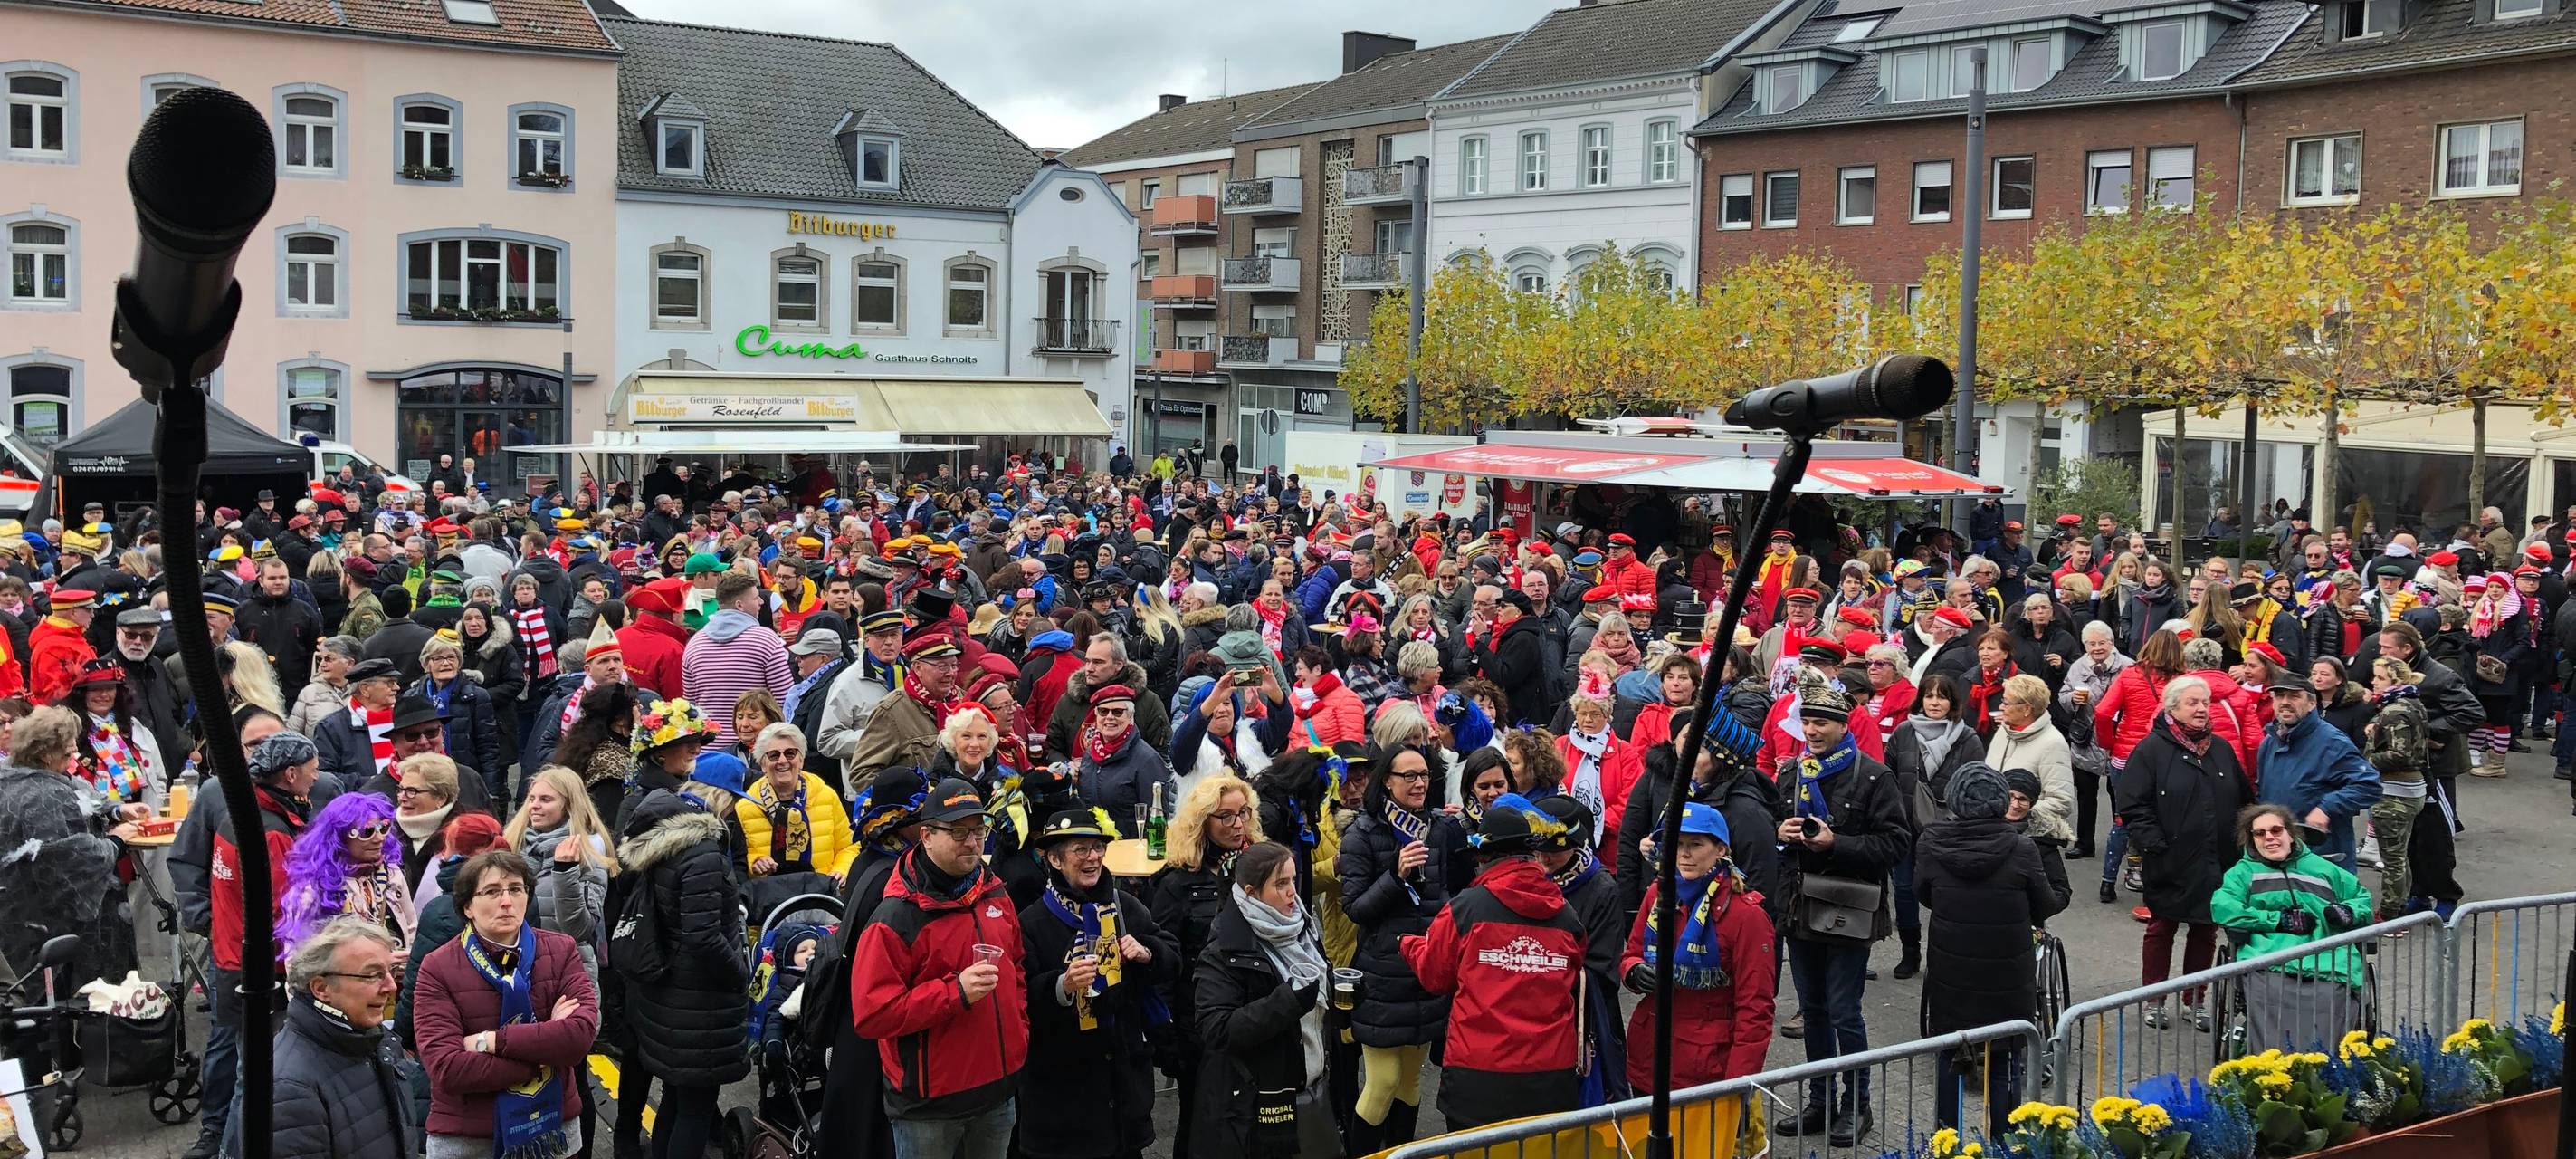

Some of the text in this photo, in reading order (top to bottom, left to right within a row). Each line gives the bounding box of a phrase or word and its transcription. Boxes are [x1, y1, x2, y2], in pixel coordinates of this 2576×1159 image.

[789, 210, 897, 242] Bitburger
[736, 324, 870, 359] Cuma
[874, 353, 928, 363] Gasthaus
[635, 398, 688, 418] Bitburger
[690, 396, 729, 405] Getränke
[739, 396, 805, 406] Fachgroßhandel
[806, 398, 855, 418] Bitburger
[712, 404, 783, 419] Rosenfeld
[1478, 952, 1569, 968] ESCHWEILER
